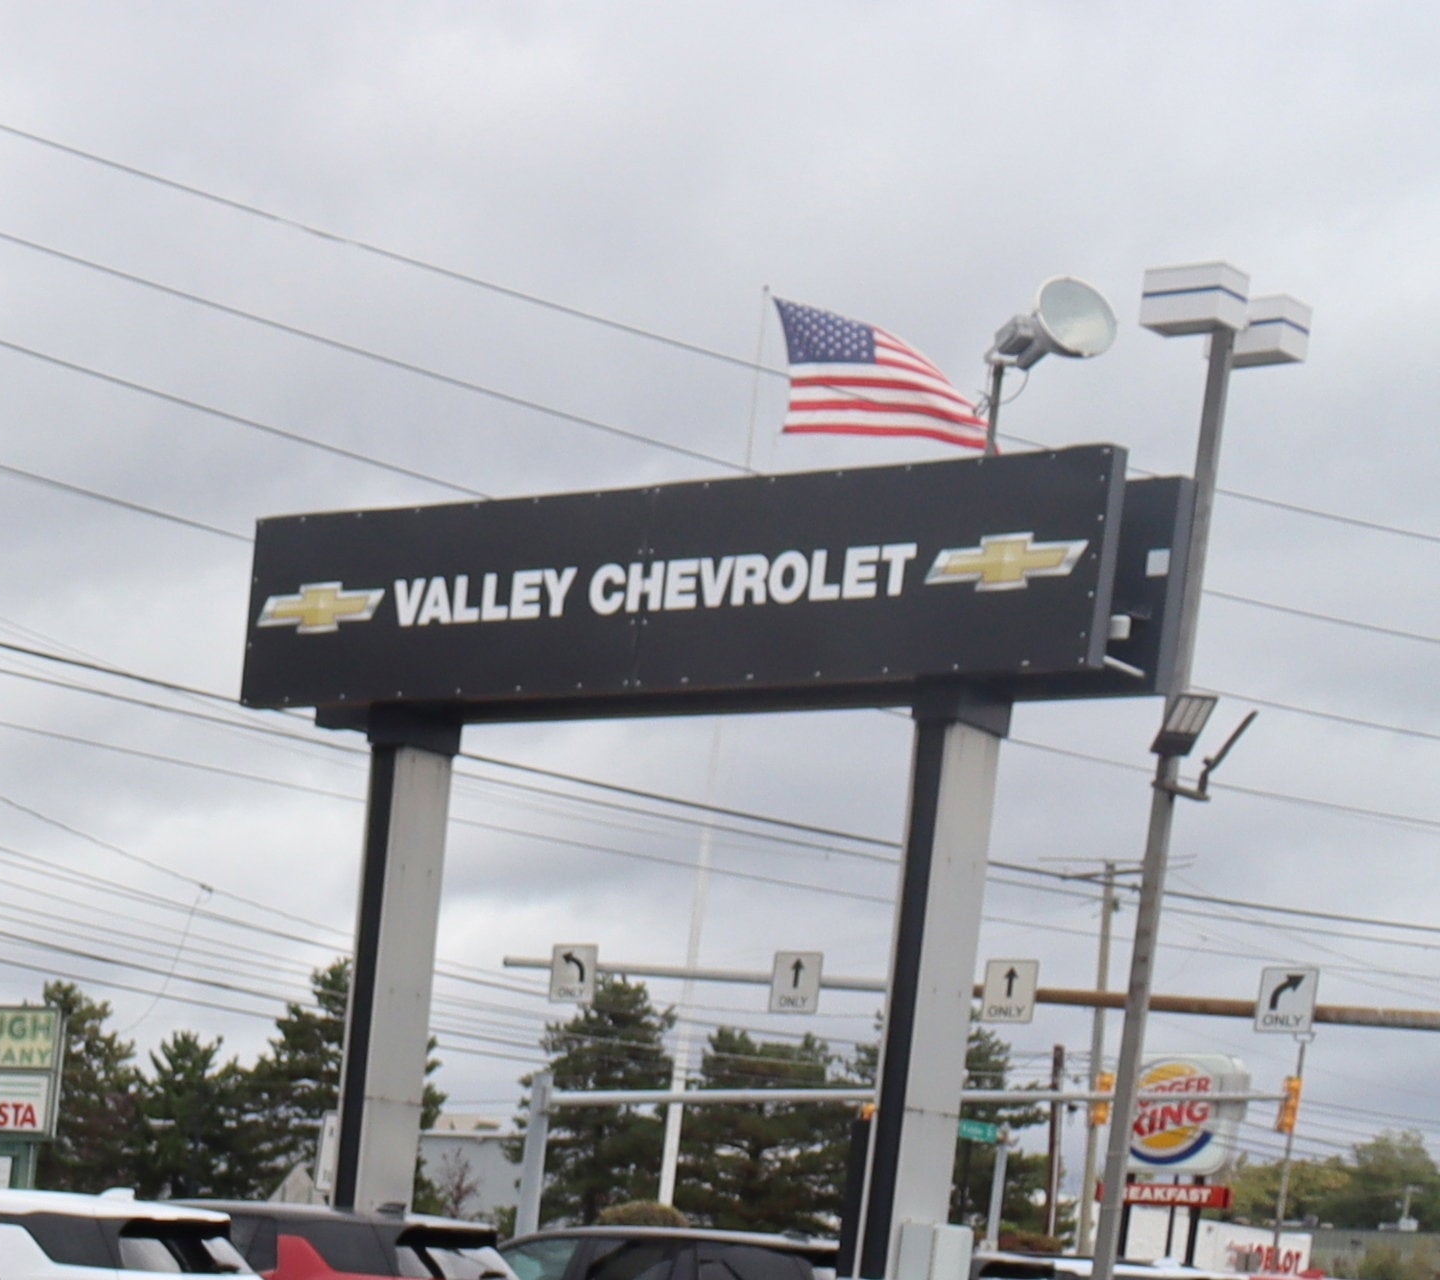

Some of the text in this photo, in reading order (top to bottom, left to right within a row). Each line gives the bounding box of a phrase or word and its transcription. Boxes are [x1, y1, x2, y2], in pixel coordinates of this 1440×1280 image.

[393, 543, 918, 628] VALLEY CHEVROLET
[987, 1004, 1025, 1018] ONLY
[1263, 1013, 1302, 1027] ONLY
[1124, 1186, 1212, 1204] EAKFAST
